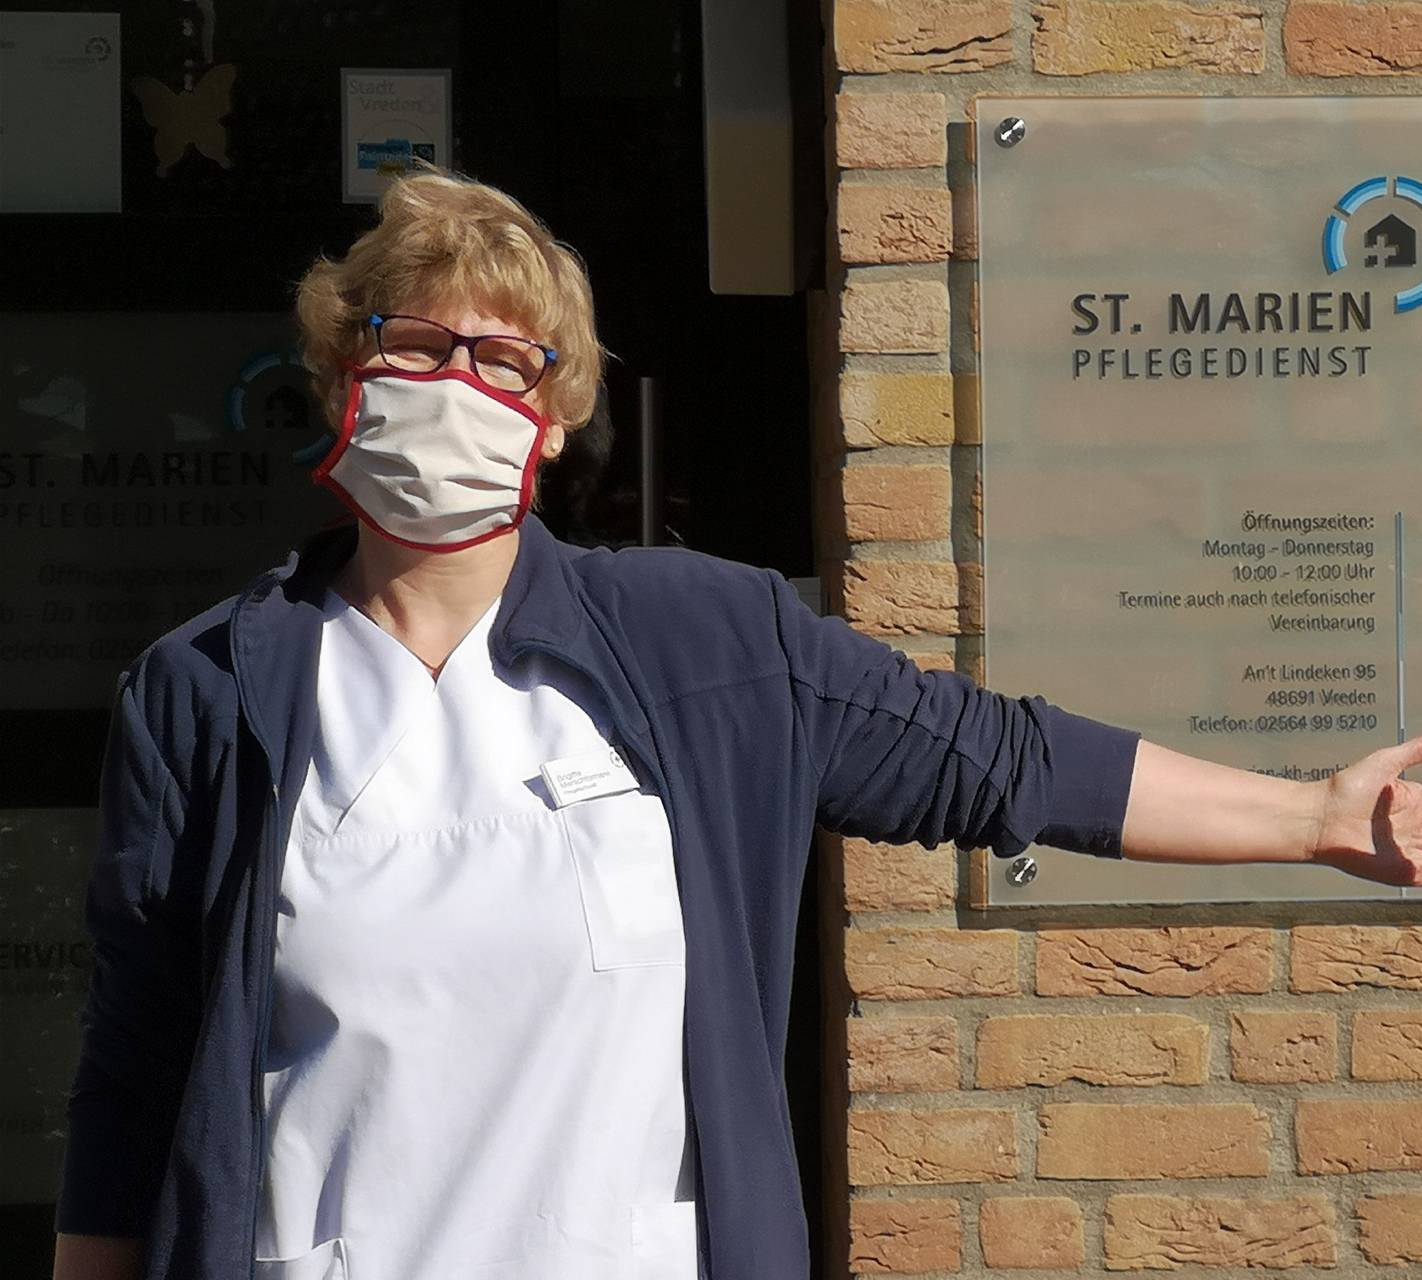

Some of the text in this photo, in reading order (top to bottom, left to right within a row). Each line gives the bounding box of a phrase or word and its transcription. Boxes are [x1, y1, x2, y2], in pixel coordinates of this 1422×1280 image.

[1072, 291, 1372, 335] ST. MARIEN
[1073, 346, 1372, 380] PFLEGEDIENST
[81, 451, 269, 487] MARIEN
[1243, 511, 1375, 534] Öffnungszeiten:
[1203, 540, 1265, 559] Montag
[1283, 539, 1374, 557] Donnerstag
[1233, 565, 1277, 582] 10:00
[1297, 564, 1341, 581] 12:00
[1345, 564, 1375, 580] Uhr
[1118, 589, 1375, 608] Termine auch nach telefonischer
[1270, 614, 1375, 634] Vereinbarung
[1280, 664, 1350, 681] Lindeken
[1354, 664, 1376, 680] 95
[1267, 689, 1376, 707] 48691 Vreden
[1190, 714, 1377, 733] Telefon: 02564 99 5210
